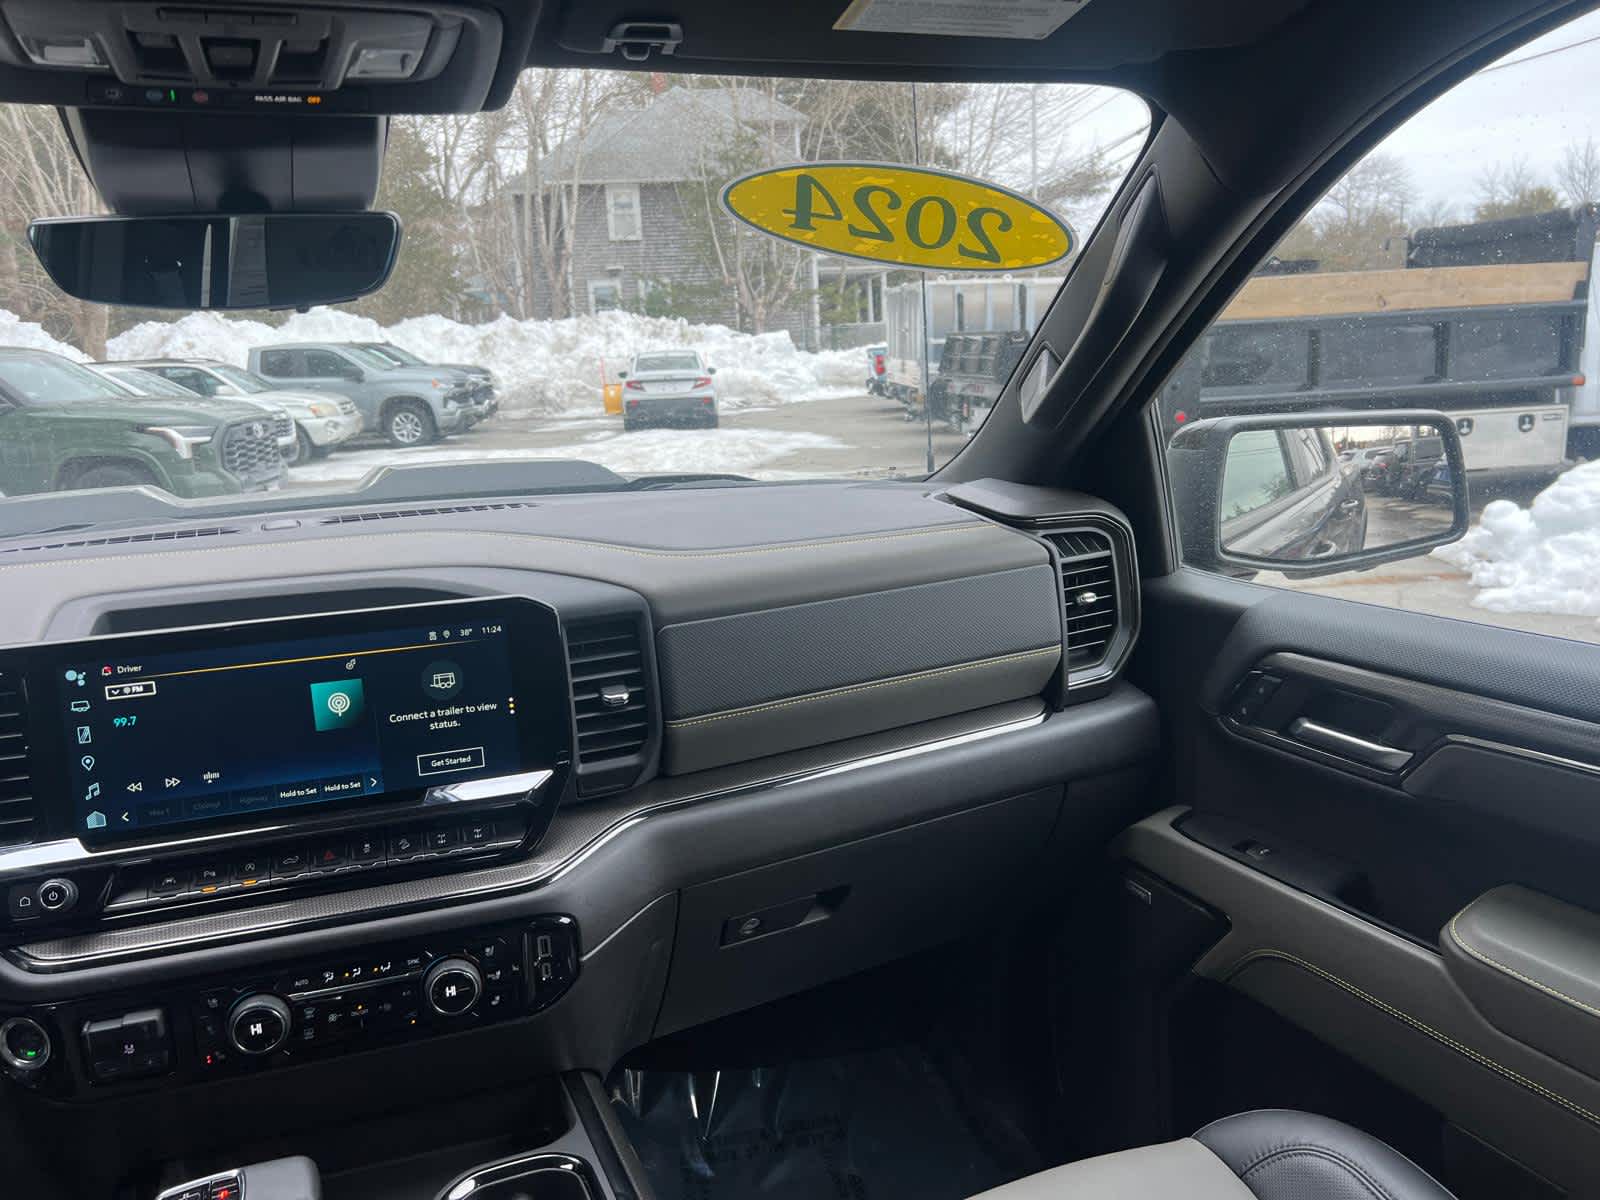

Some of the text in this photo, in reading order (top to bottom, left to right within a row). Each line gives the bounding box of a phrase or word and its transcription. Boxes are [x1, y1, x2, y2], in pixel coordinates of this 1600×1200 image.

[287, 95, 302, 103] BAG
[307, 96, 321, 104] OFF
[481, 625, 502, 634] 11:24
[117, 665, 142, 674] Driver
[132, 685, 144, 693] FM
[389, 710, 428, 723] Connect
[437, 706, 464, 717] trailer
[465, 705, 476, 713] to
[476, 703, 497, 712] view
[113, 715, 137, 728] 99.7
[429, 719, 461, 730] status.
[431, 755, 471, 768] Get Started
[324, 784, 341, 792] Hold
[349, 781, 361, 789] Set
[280, 789, 296, 798] Hold
[445, 985, 457, 997] HI
[250, 1023, 263, 1036] HI
